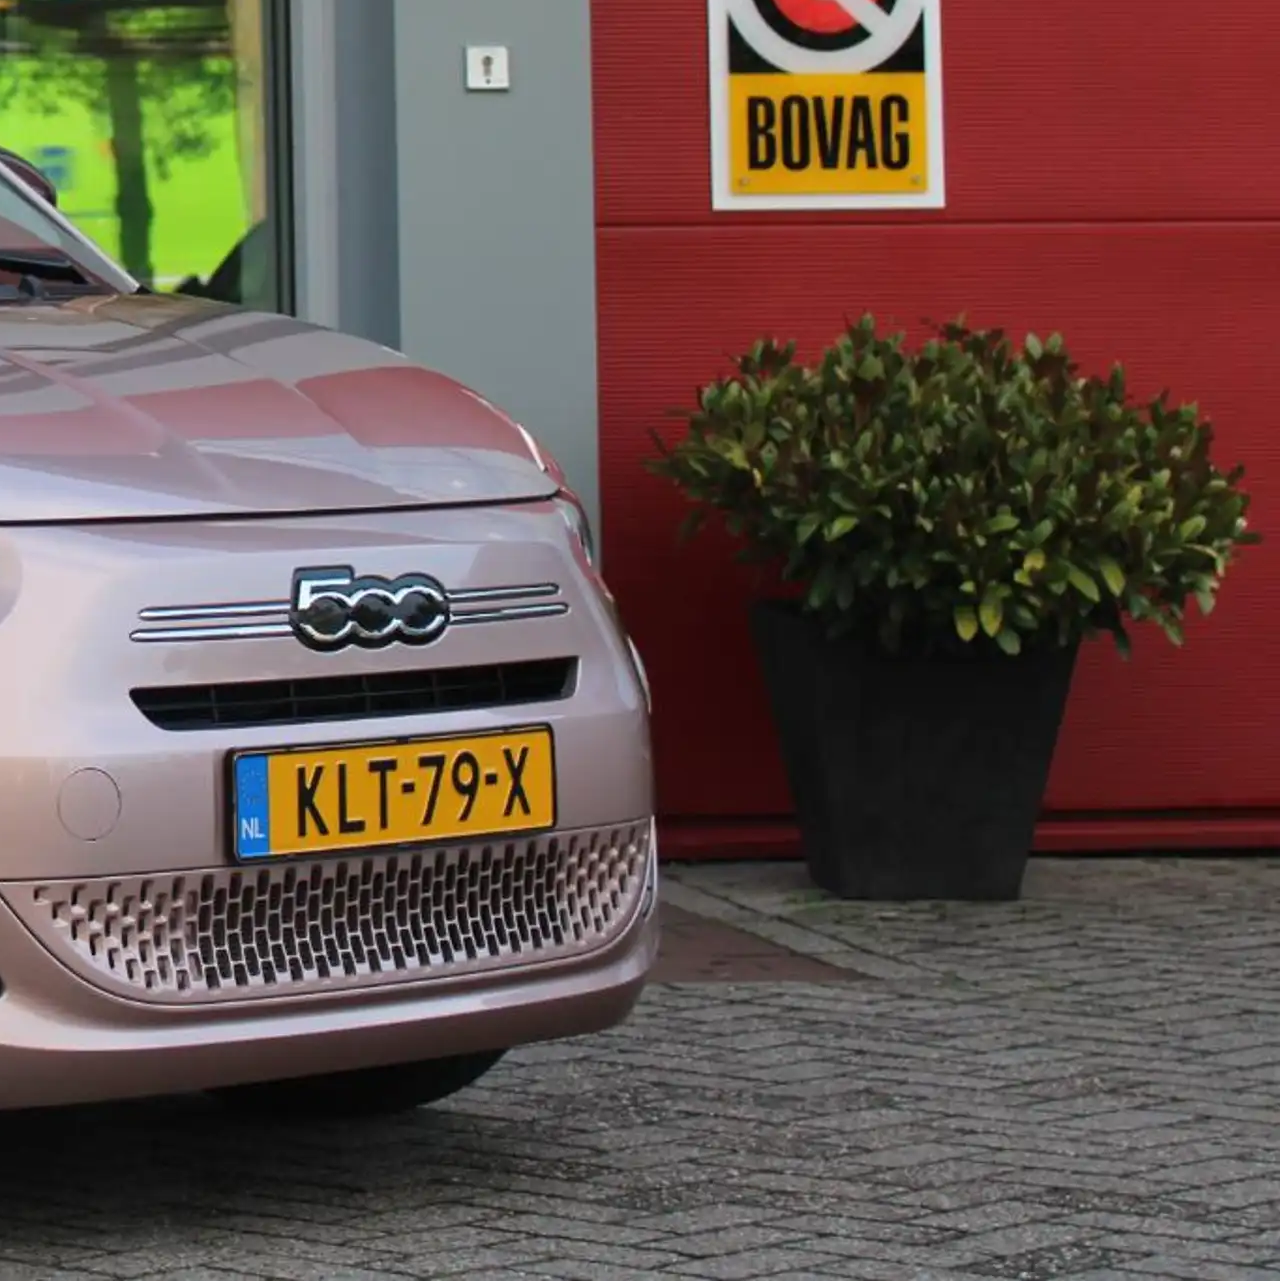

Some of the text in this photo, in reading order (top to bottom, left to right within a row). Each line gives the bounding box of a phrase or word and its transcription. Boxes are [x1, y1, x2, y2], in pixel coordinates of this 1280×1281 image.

[747, 94, 910, 171] BOVAG
[292, 568, 449, 650] 500
[241, 816, 267, 839] NL
[296, 745, 532, 838] KLT-79-X
